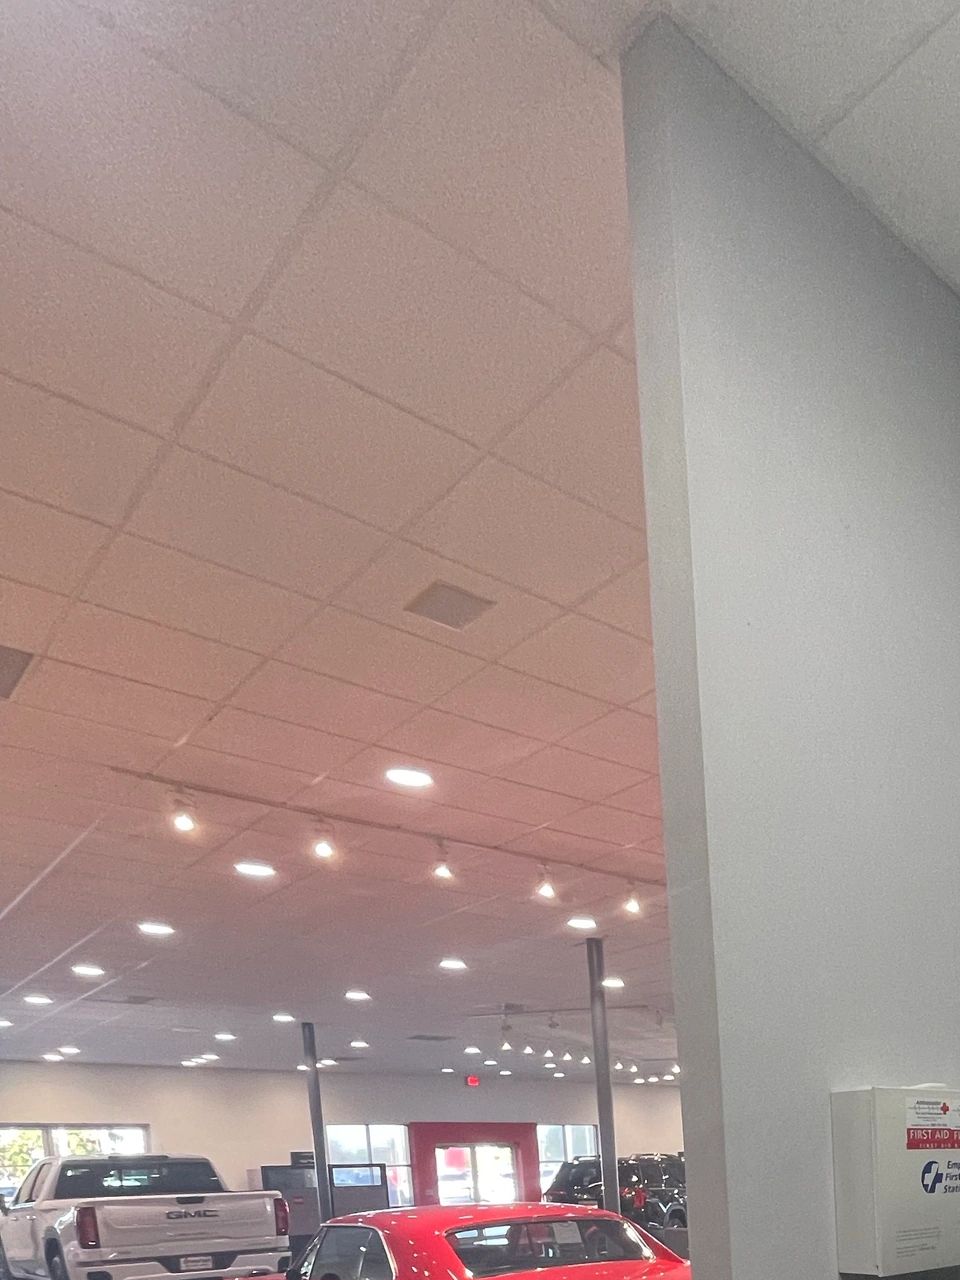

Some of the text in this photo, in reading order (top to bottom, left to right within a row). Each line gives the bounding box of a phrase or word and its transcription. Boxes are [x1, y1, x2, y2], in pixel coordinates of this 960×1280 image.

[910, 1129, 950, 1140] FIRST AID
[166, 1210, 219, 1220] GMC
